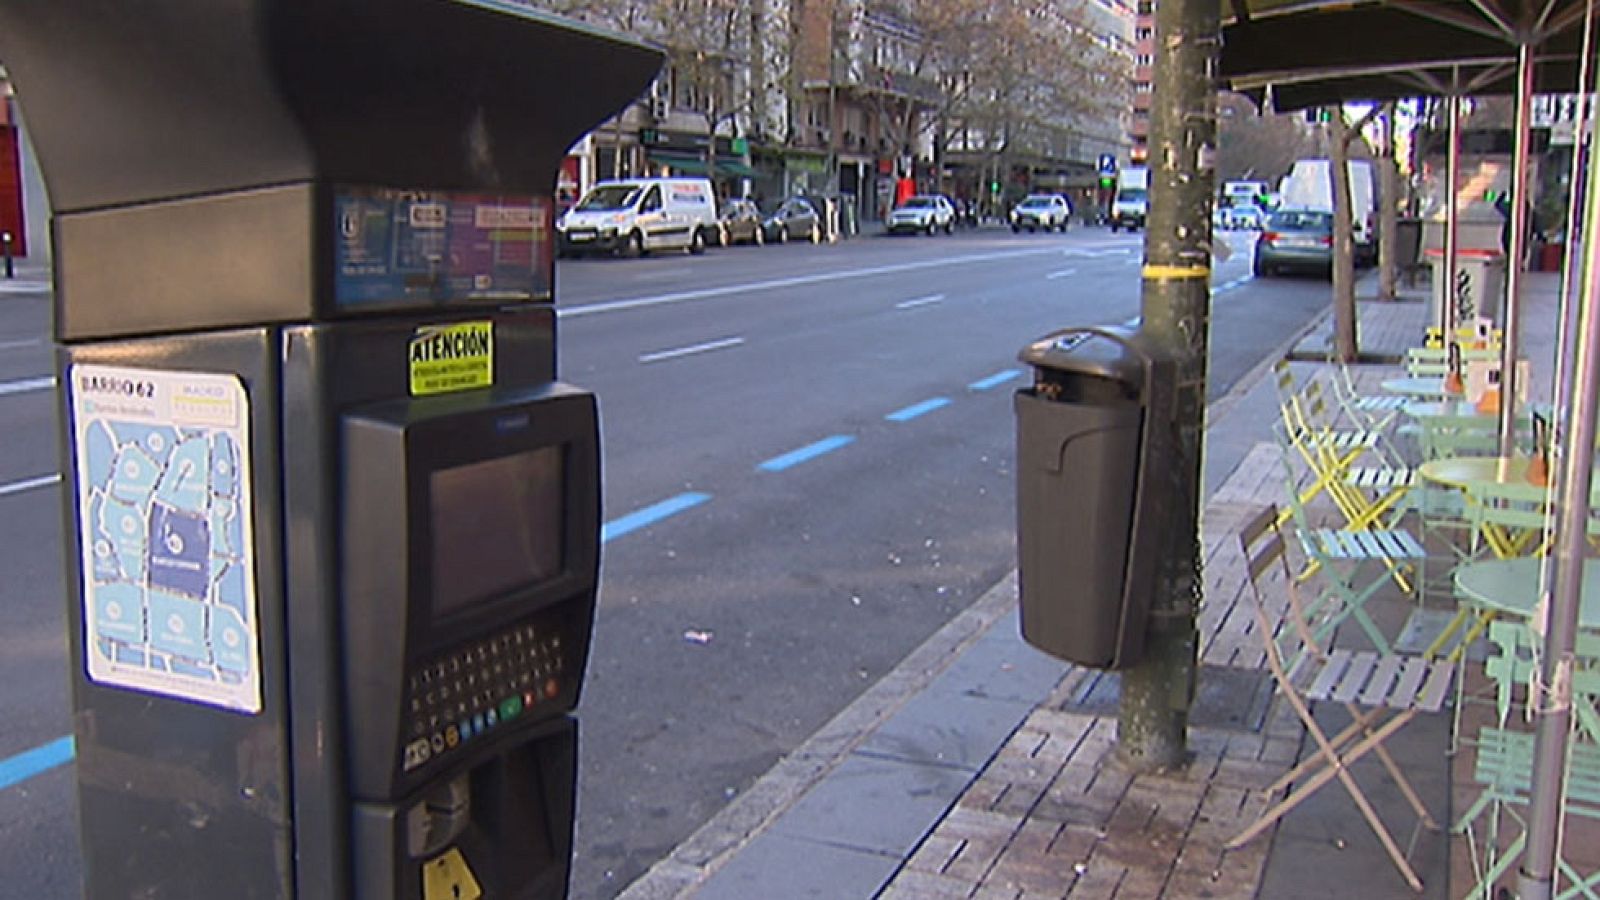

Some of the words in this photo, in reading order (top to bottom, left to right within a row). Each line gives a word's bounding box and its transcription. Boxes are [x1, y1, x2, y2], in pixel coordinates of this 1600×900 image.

[411, 326, 489, 362] ATENCIÓN
[81, 376, 133, 395] BARRIO
[136, 381, 155, 398] 62
